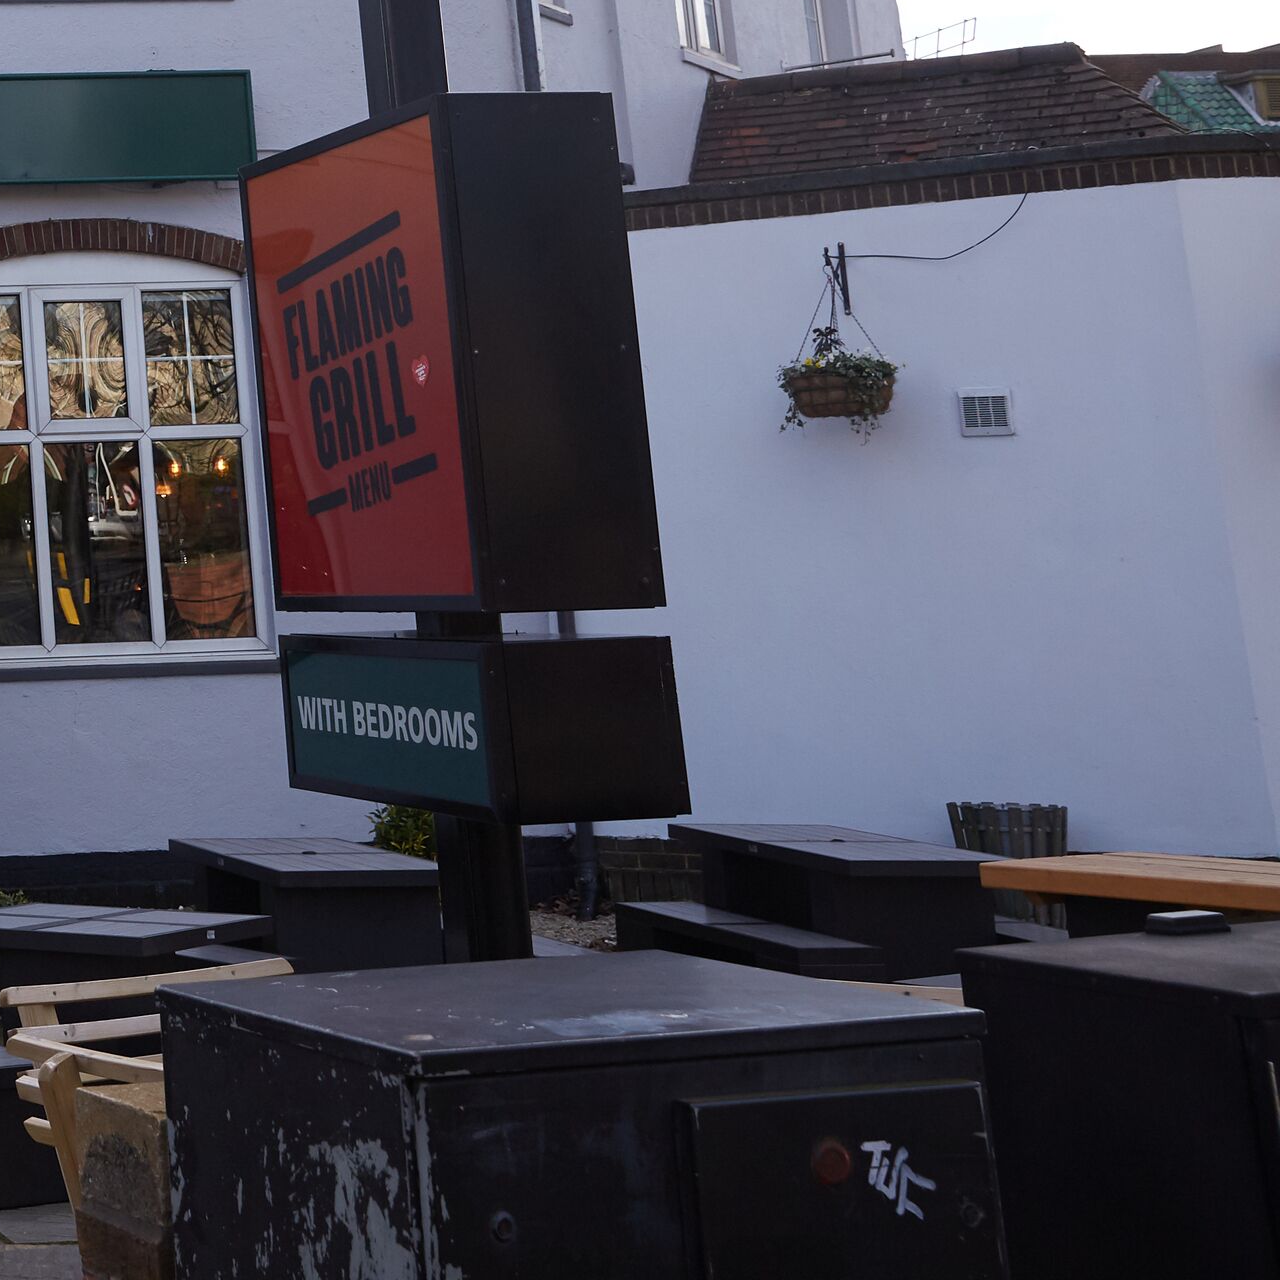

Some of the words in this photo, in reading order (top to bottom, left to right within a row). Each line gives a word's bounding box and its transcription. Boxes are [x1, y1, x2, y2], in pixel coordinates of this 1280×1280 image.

[283, 246, 414, 381] FLAMING
[309, 340, 417, 470] GRILL
[348, 461, 391, 512] MENU
[297, 695, 348, 735] WITH
[352, 700, 479, 751] BEDROOMS
